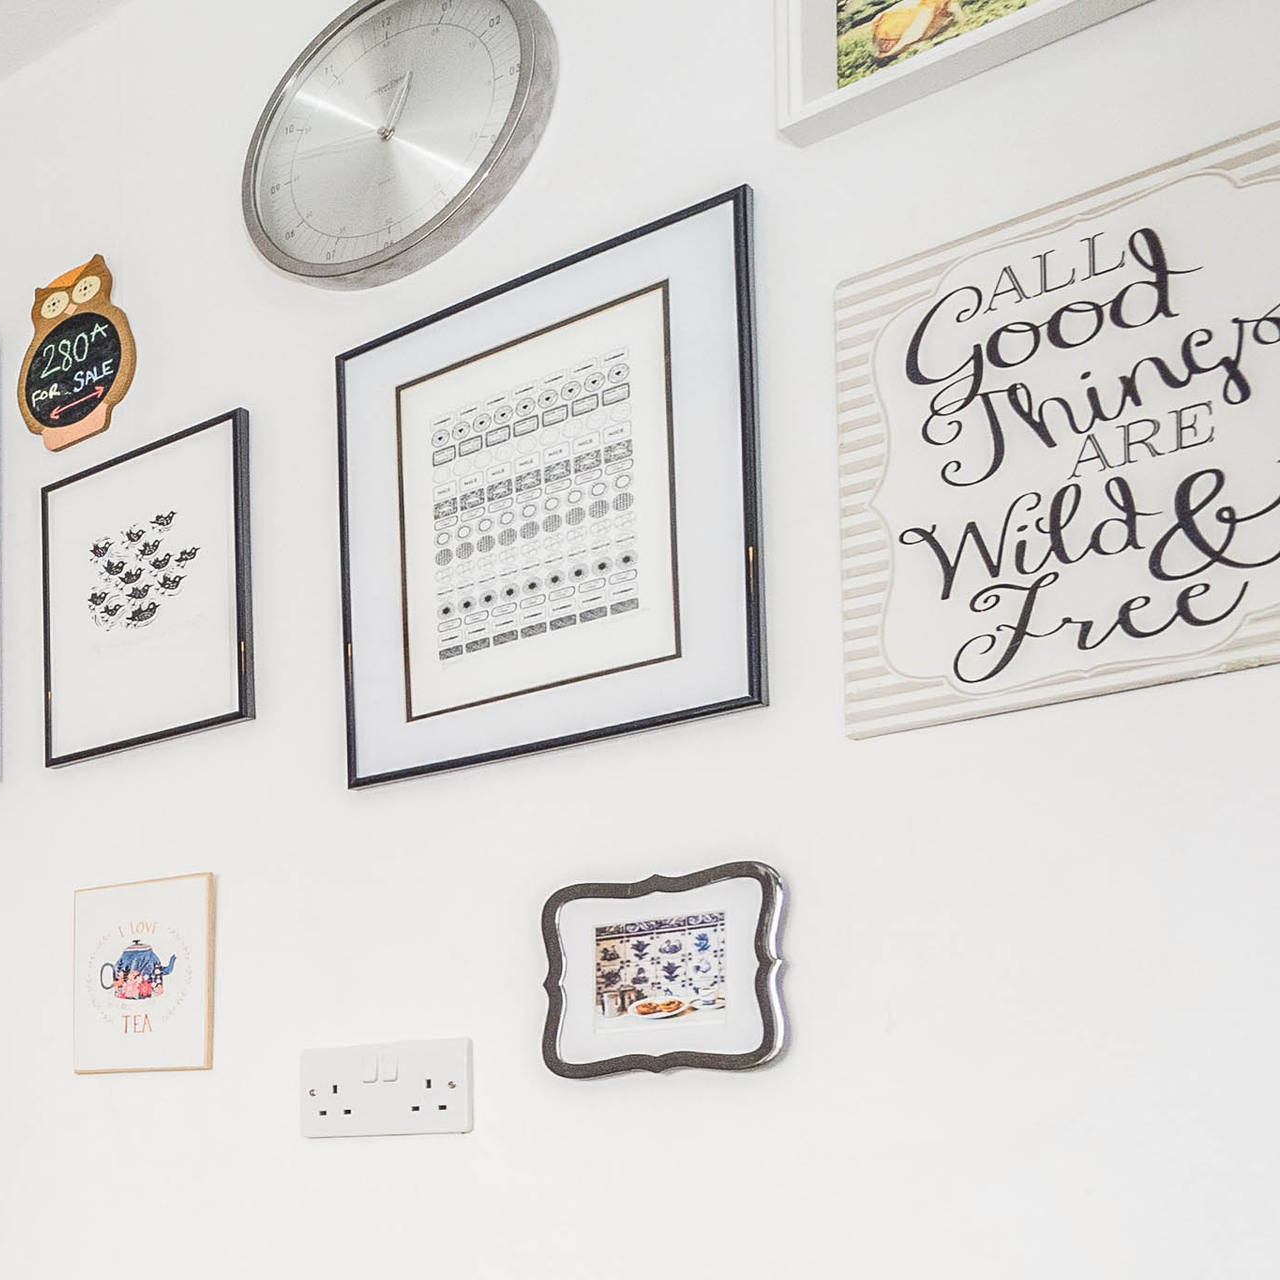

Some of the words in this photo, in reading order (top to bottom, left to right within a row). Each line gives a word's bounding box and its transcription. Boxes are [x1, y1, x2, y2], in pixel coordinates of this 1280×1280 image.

[983, 231, 1127, 314] ALL
[905, 226, 1204, 417] Good
[30, 382, 61, 408] FOR
[72, 358, 115, 393] SALE
[1066, 400, 1216, 481] ARE
[898, 475, 1163, 602] Wild
[953, 571, 1250, 685] Free
[129, 920, 159, 936] LOVE
[121, 1013, 153, 1035] TEA
